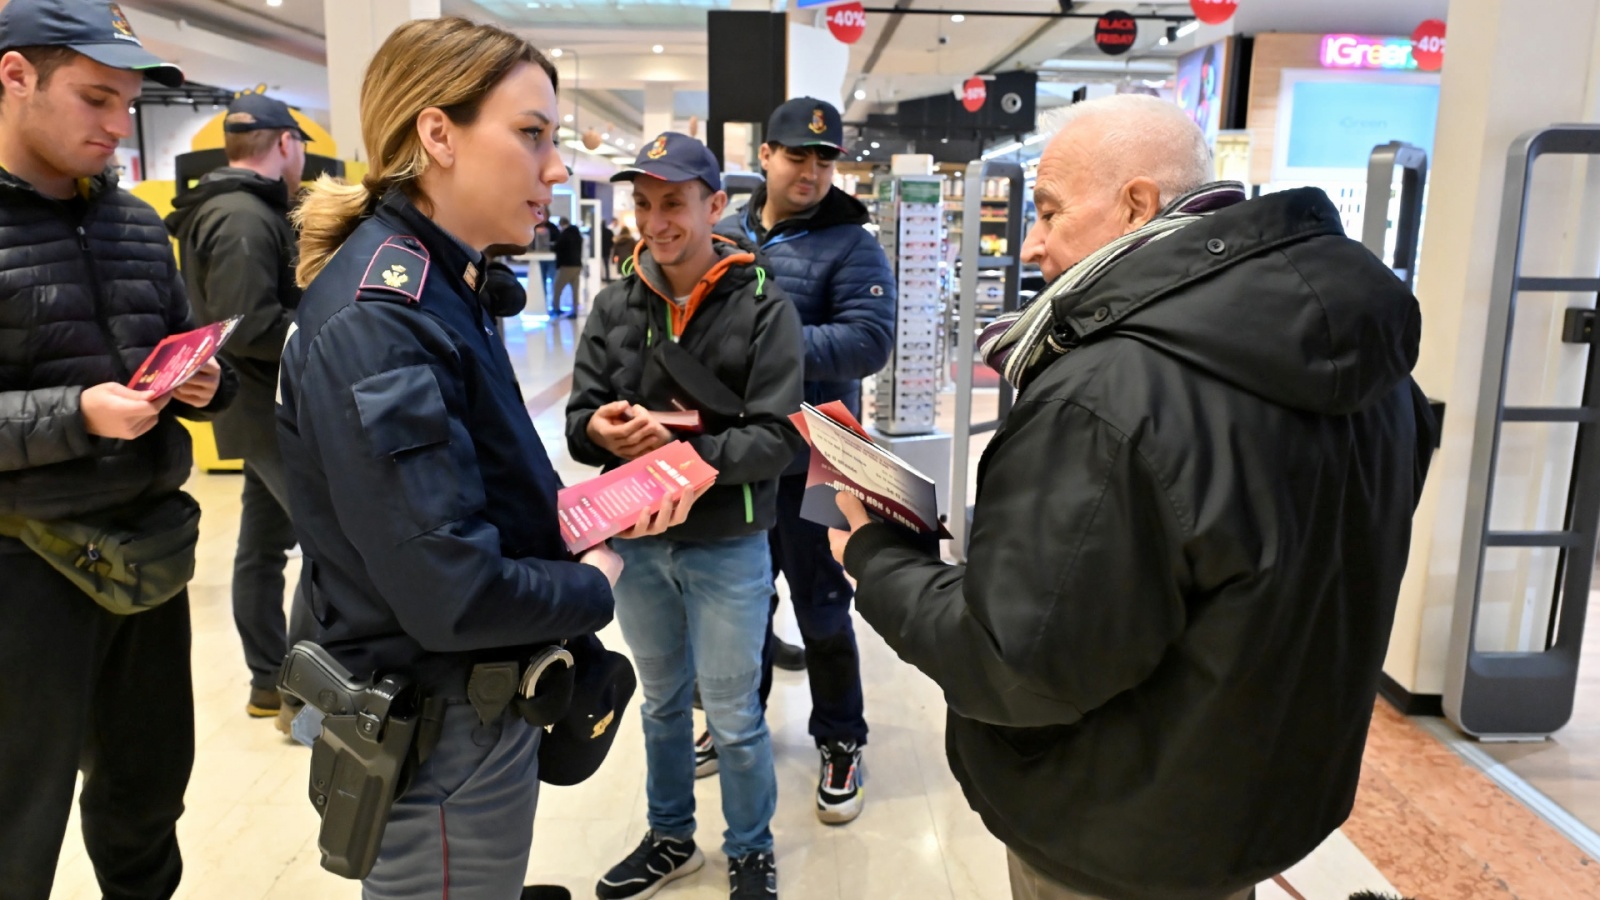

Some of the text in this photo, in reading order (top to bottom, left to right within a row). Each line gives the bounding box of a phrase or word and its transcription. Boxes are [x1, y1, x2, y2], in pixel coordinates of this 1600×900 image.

[826, 10, 866, 27] -40%
[1099, 17, 1135, 29] BLACK
[1096, 33, 1135, 45] FRIDAY
